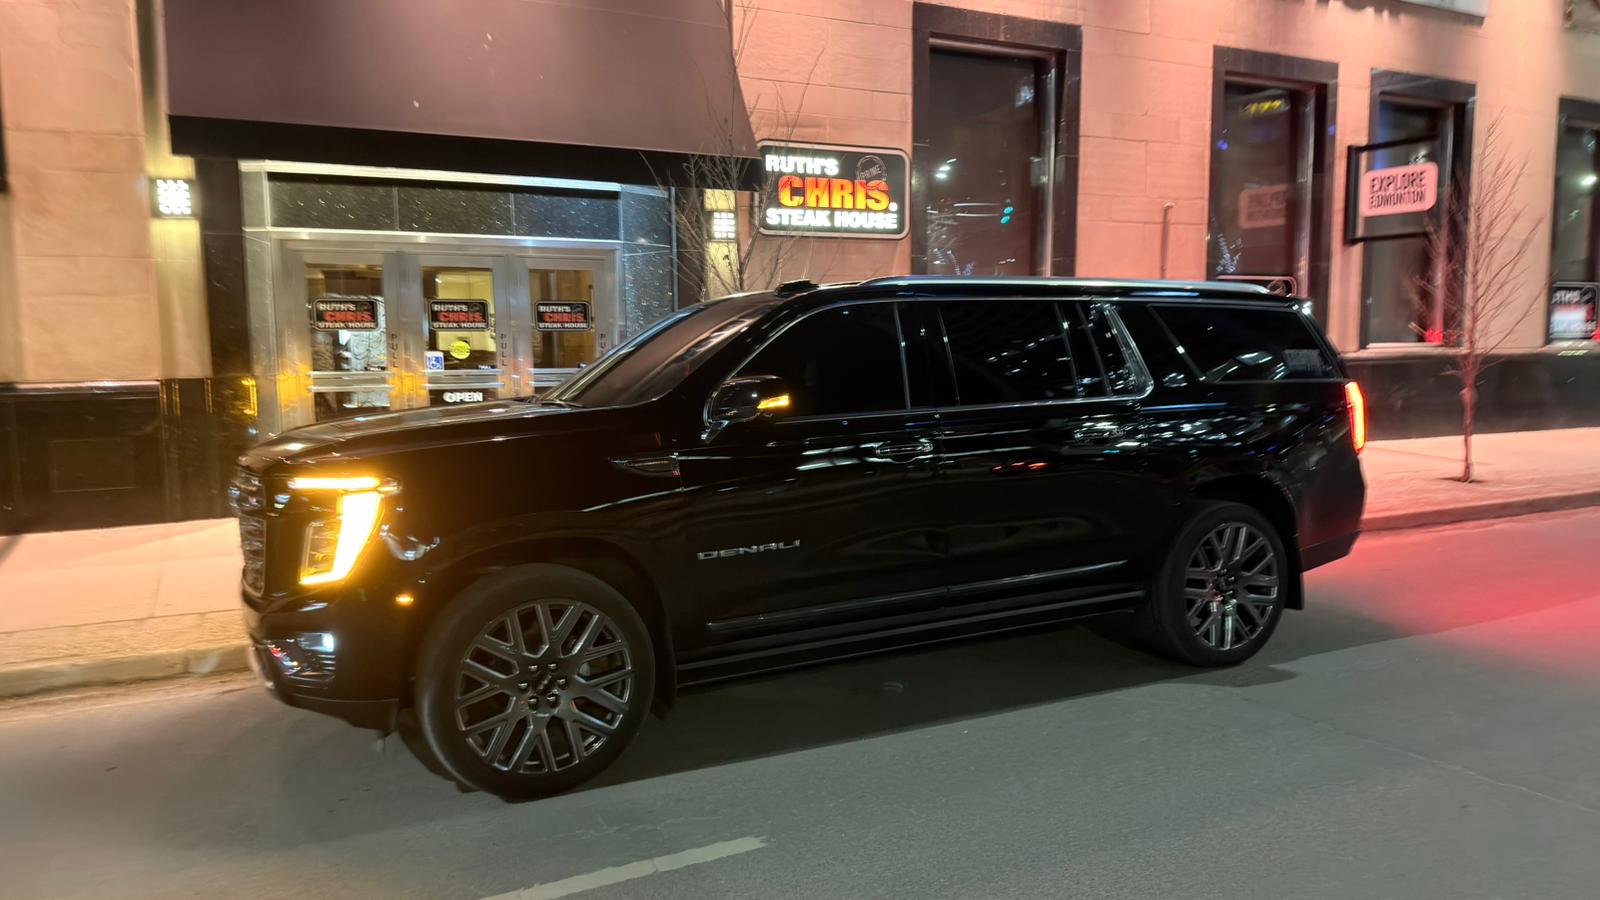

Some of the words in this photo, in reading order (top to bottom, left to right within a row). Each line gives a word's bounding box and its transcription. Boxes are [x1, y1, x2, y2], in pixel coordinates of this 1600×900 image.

[764, 154, 839, 176] RUTH'S
[1370, 170, 1427, 194] EXPLORE
[1368, 189, 1426, 210] EDMONTON
[765, 207, 831, 227] STEAK
[833, 210, 898, 229] HOUSE
[317, 303, 356, 311] RUTH'S
[432, 304, 468, 312] RUTH'S
[538, 305, 572, 313] RUTH'S
[443, 391, 483, 403] OPEN
[697, 539, 800, 561] DENALI
